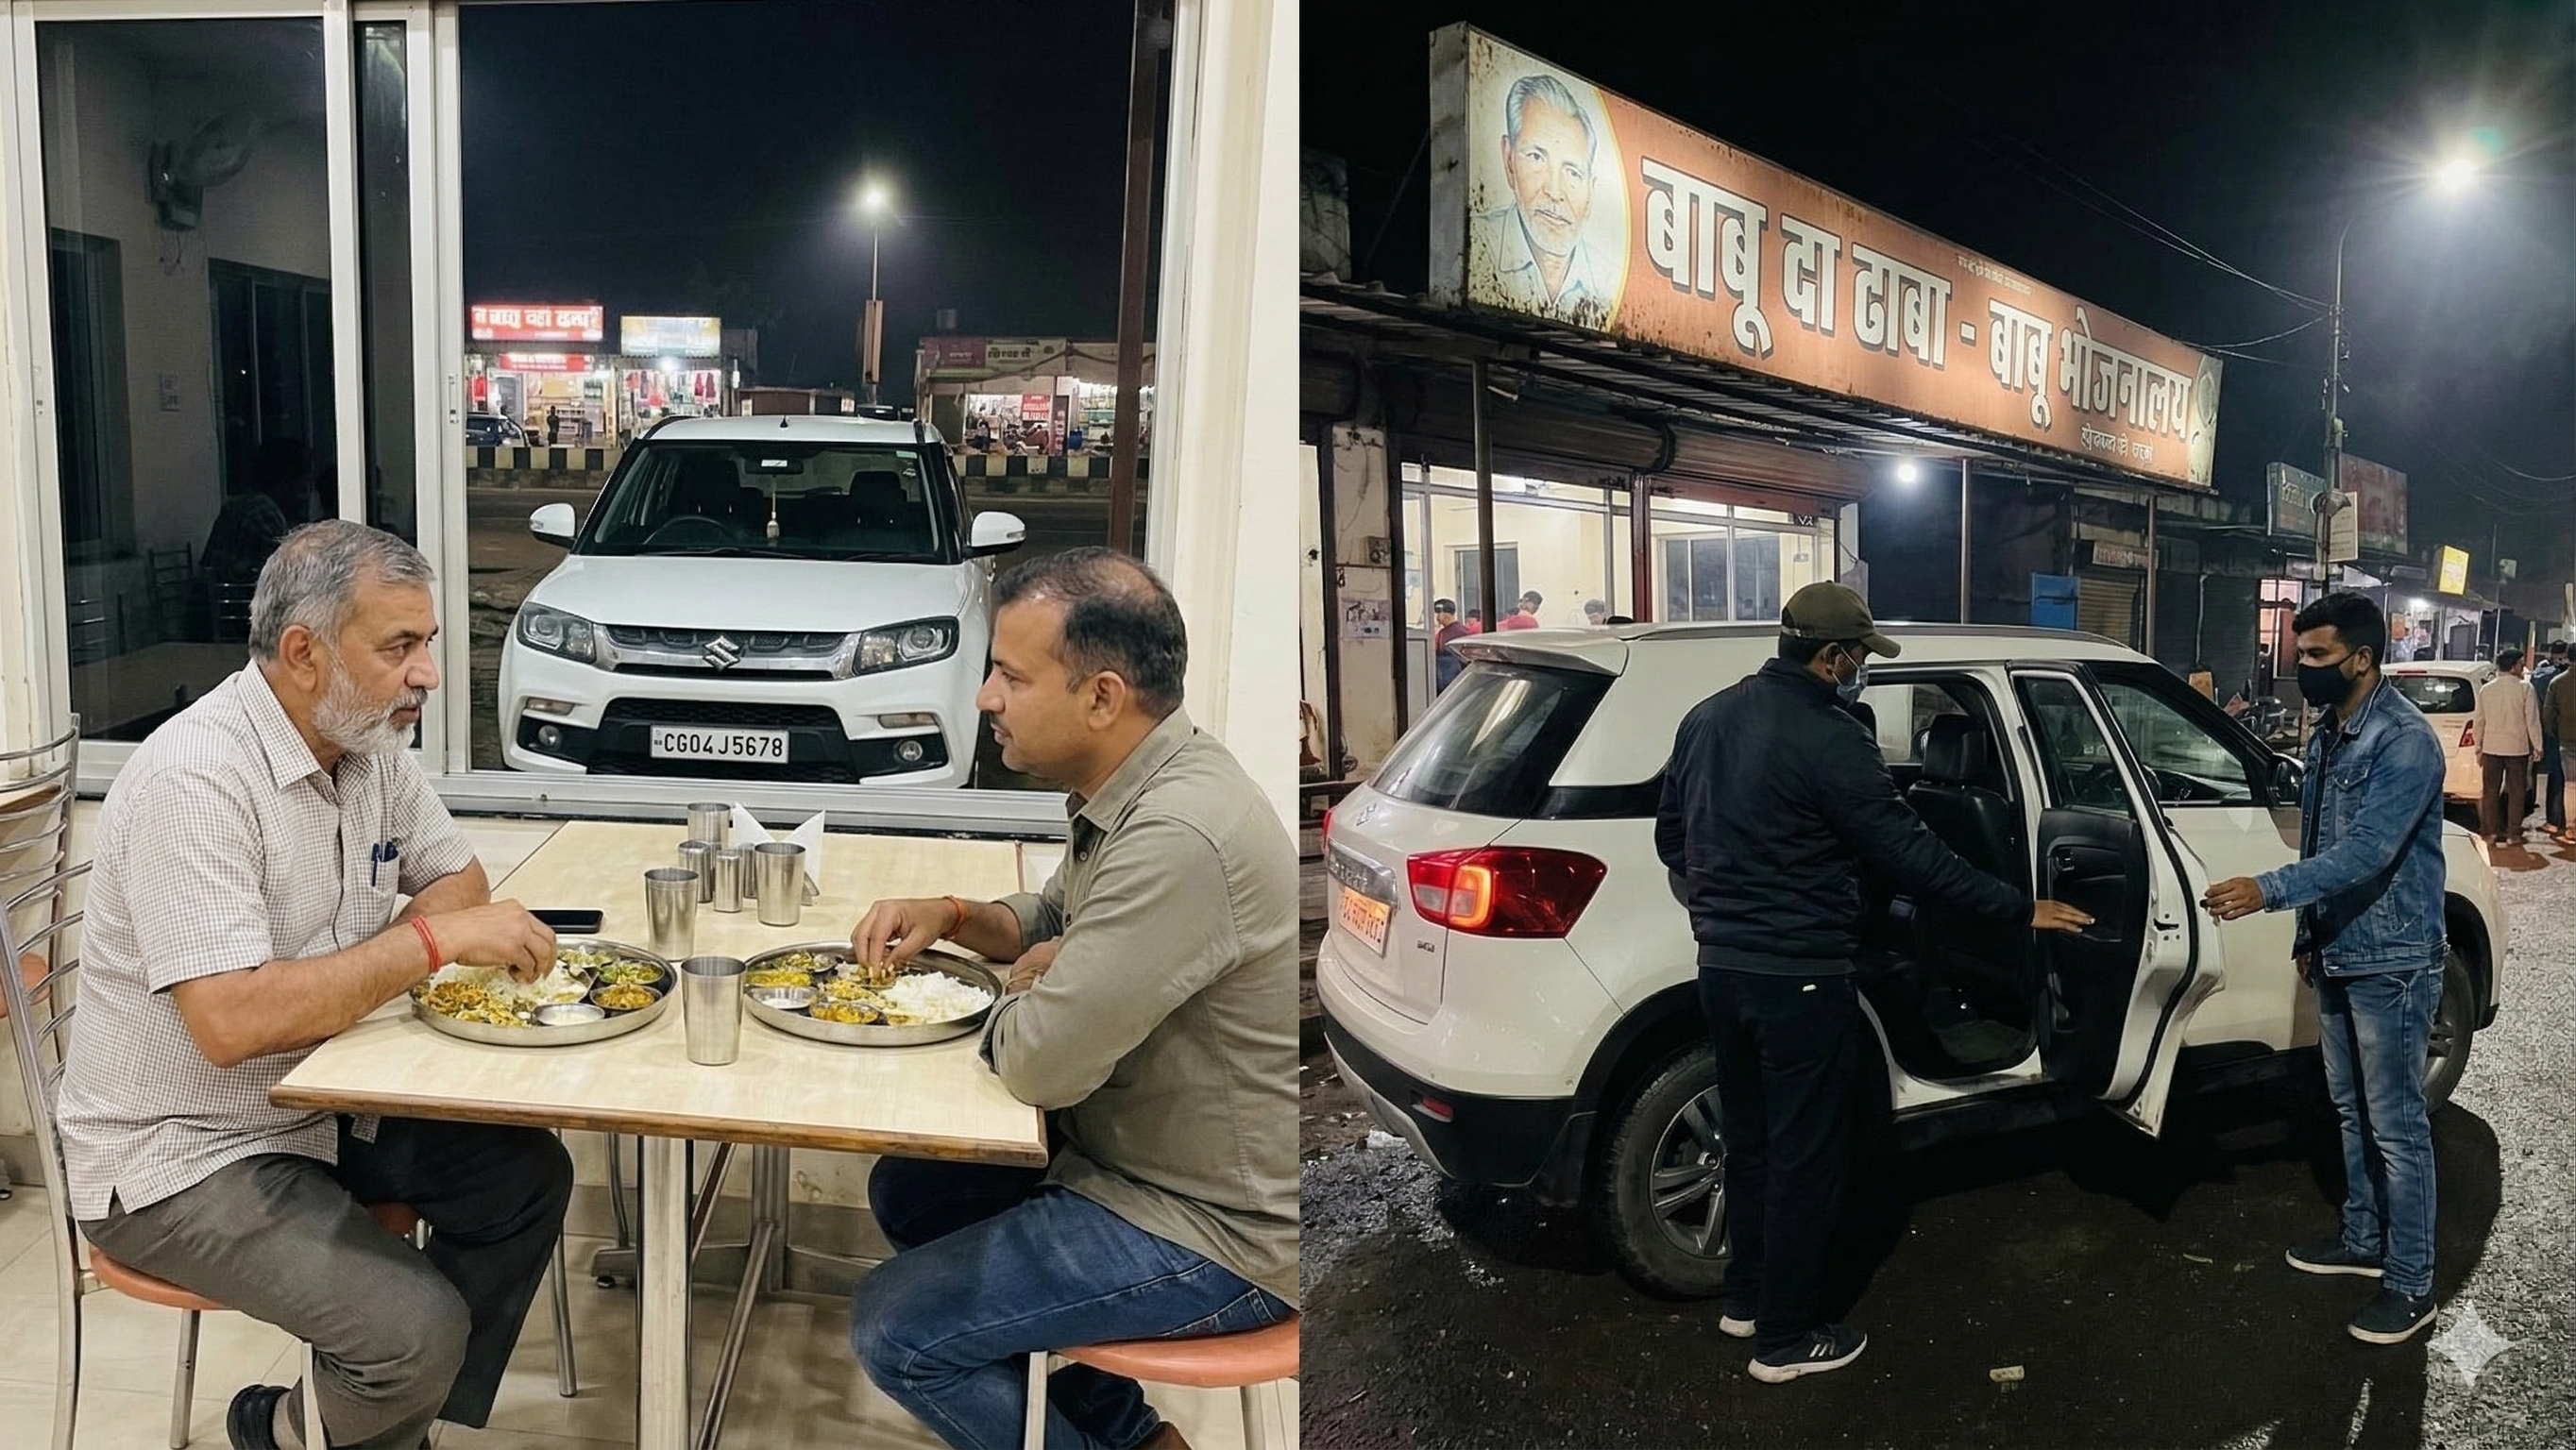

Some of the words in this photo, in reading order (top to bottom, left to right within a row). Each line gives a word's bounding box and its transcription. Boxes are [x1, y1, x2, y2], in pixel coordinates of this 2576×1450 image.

[1641, 156, 1772, 359] बाबू
[1780, 212, 1841, 336] दा
[1852, 242, 1952, 370] ढाबा
[1989, 297, 2053, 432] बाबू
[2059, 305, 2193, 440] भोजनालय
[664, 733, 784, 757] CG04J5678
